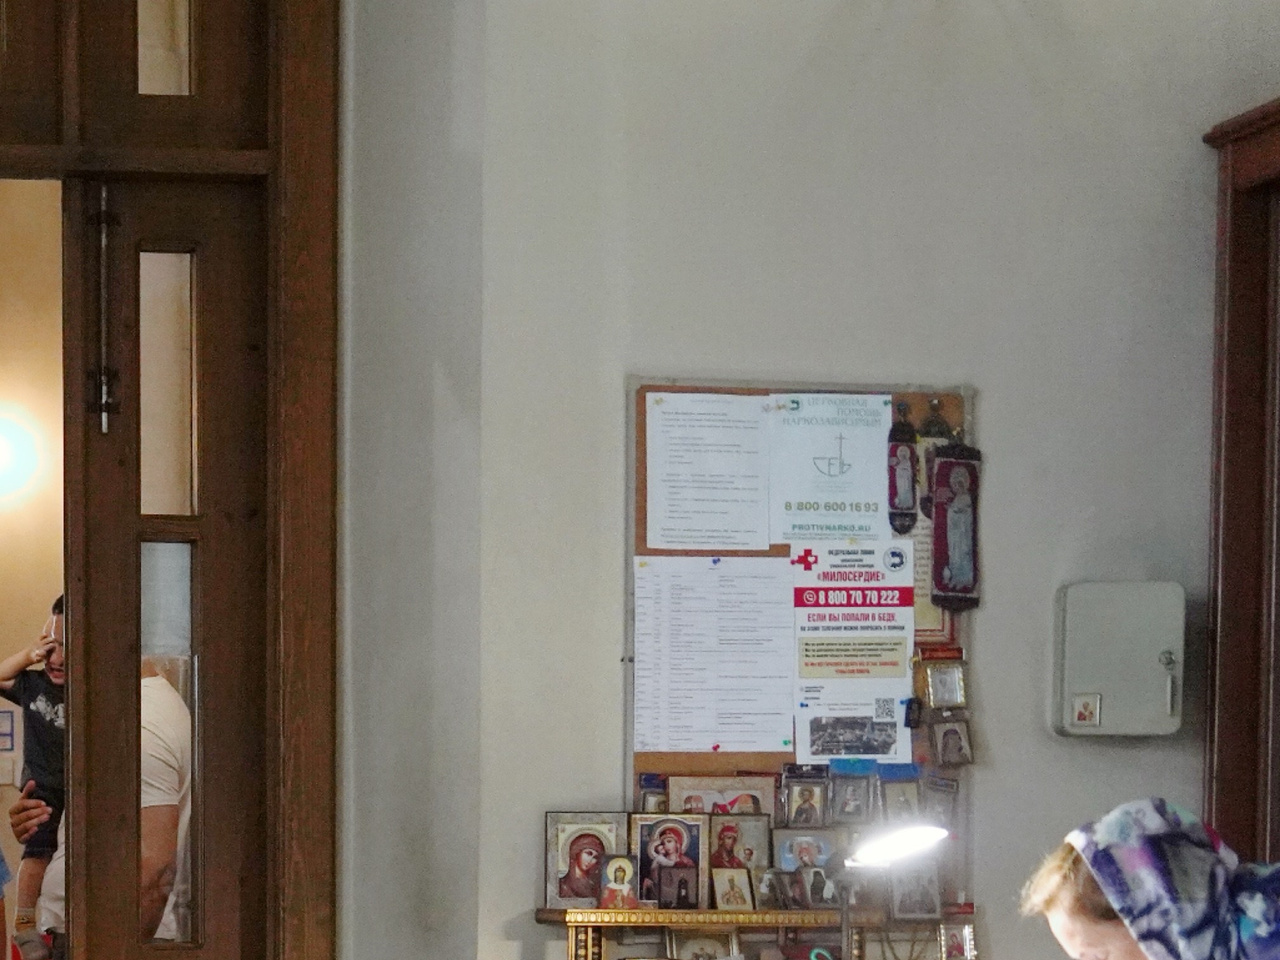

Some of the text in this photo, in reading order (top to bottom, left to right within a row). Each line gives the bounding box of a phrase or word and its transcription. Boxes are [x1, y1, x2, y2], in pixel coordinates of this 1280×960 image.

[784, 501, 793, 512] 8
[796, 501, 820, 512] 800
[823, 501, 847, 513] 600
[791, 523, 872, 533] PROTIVNARKO.RU
[817, 571, 886, 583] «МИЛОСЕРДИЕ»
[818, 590, 900, 604] 8 800 70 70 222
[807, 612, 827, 623] ЕСЛИ
[828, 612, 840, 623] ВЫ
[841, 612, 870, 623] ПОПАЛИ
[871, 612, 876, 623] В
